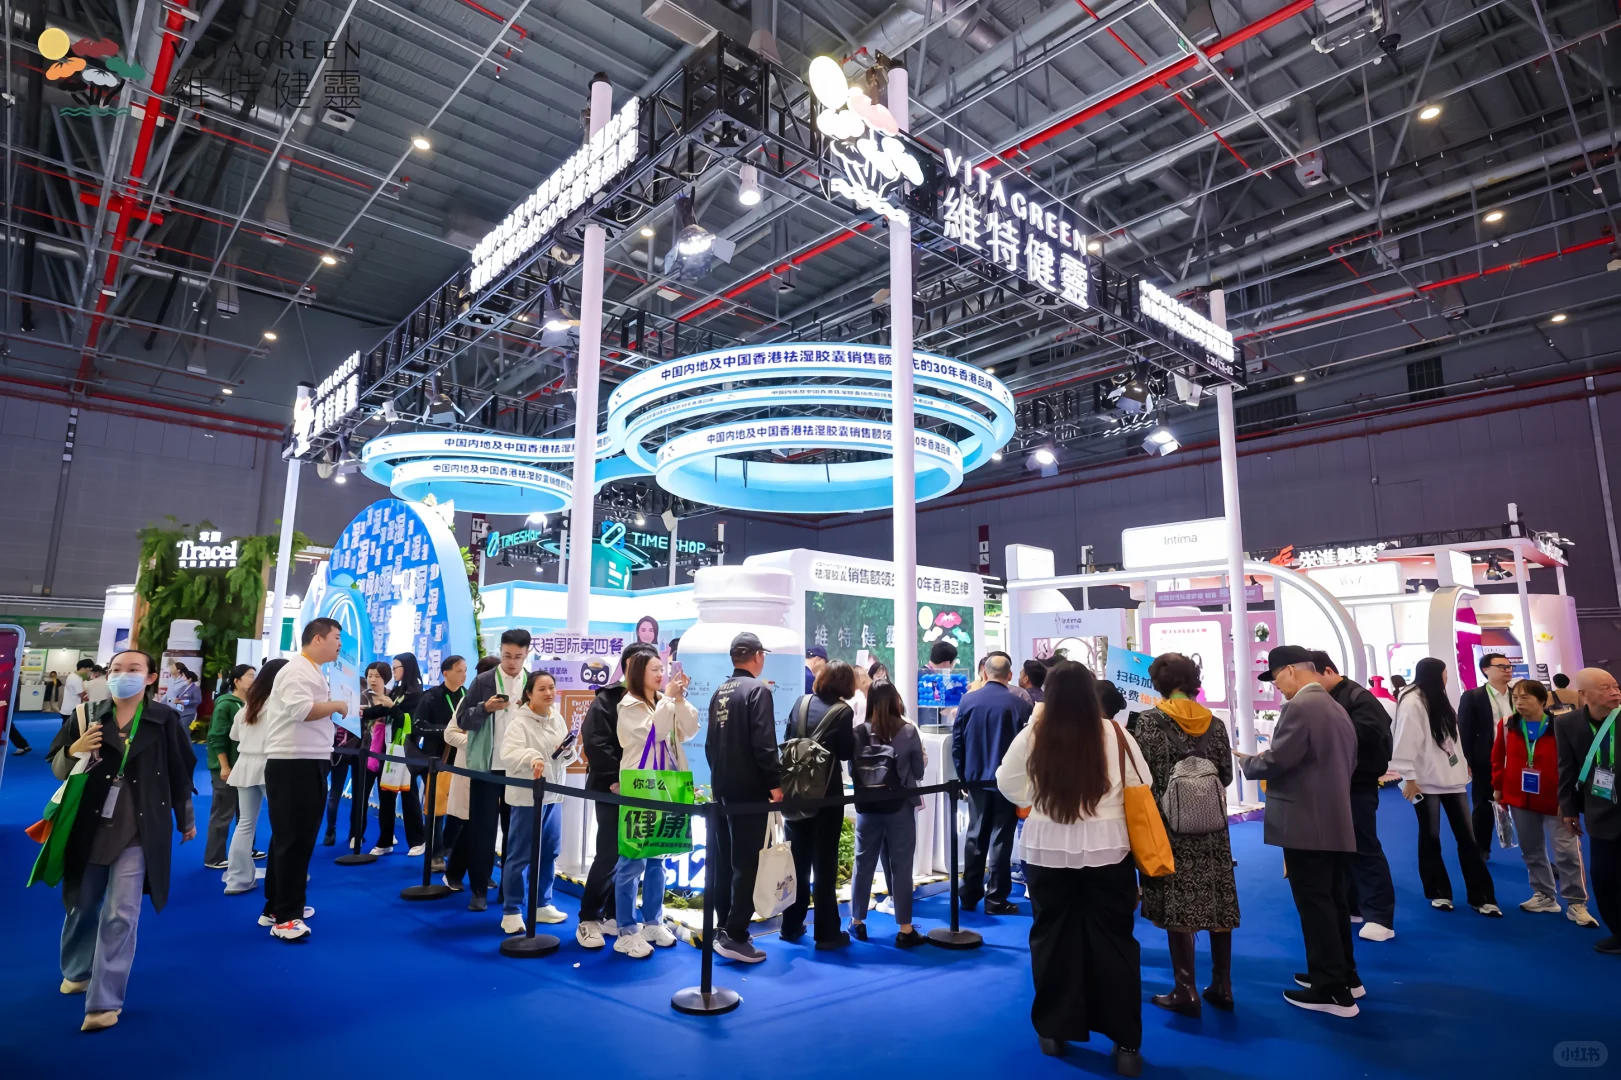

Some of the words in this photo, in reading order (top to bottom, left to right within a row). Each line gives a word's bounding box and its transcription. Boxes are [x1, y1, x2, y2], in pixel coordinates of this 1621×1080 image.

[943, 147, 1087, 256] VITAGREEN
[943, 187, 1090, 310] 維特健靈
[176, 540, 238, 560] Tracel
[1163, 533, 1198, 546] Intima
